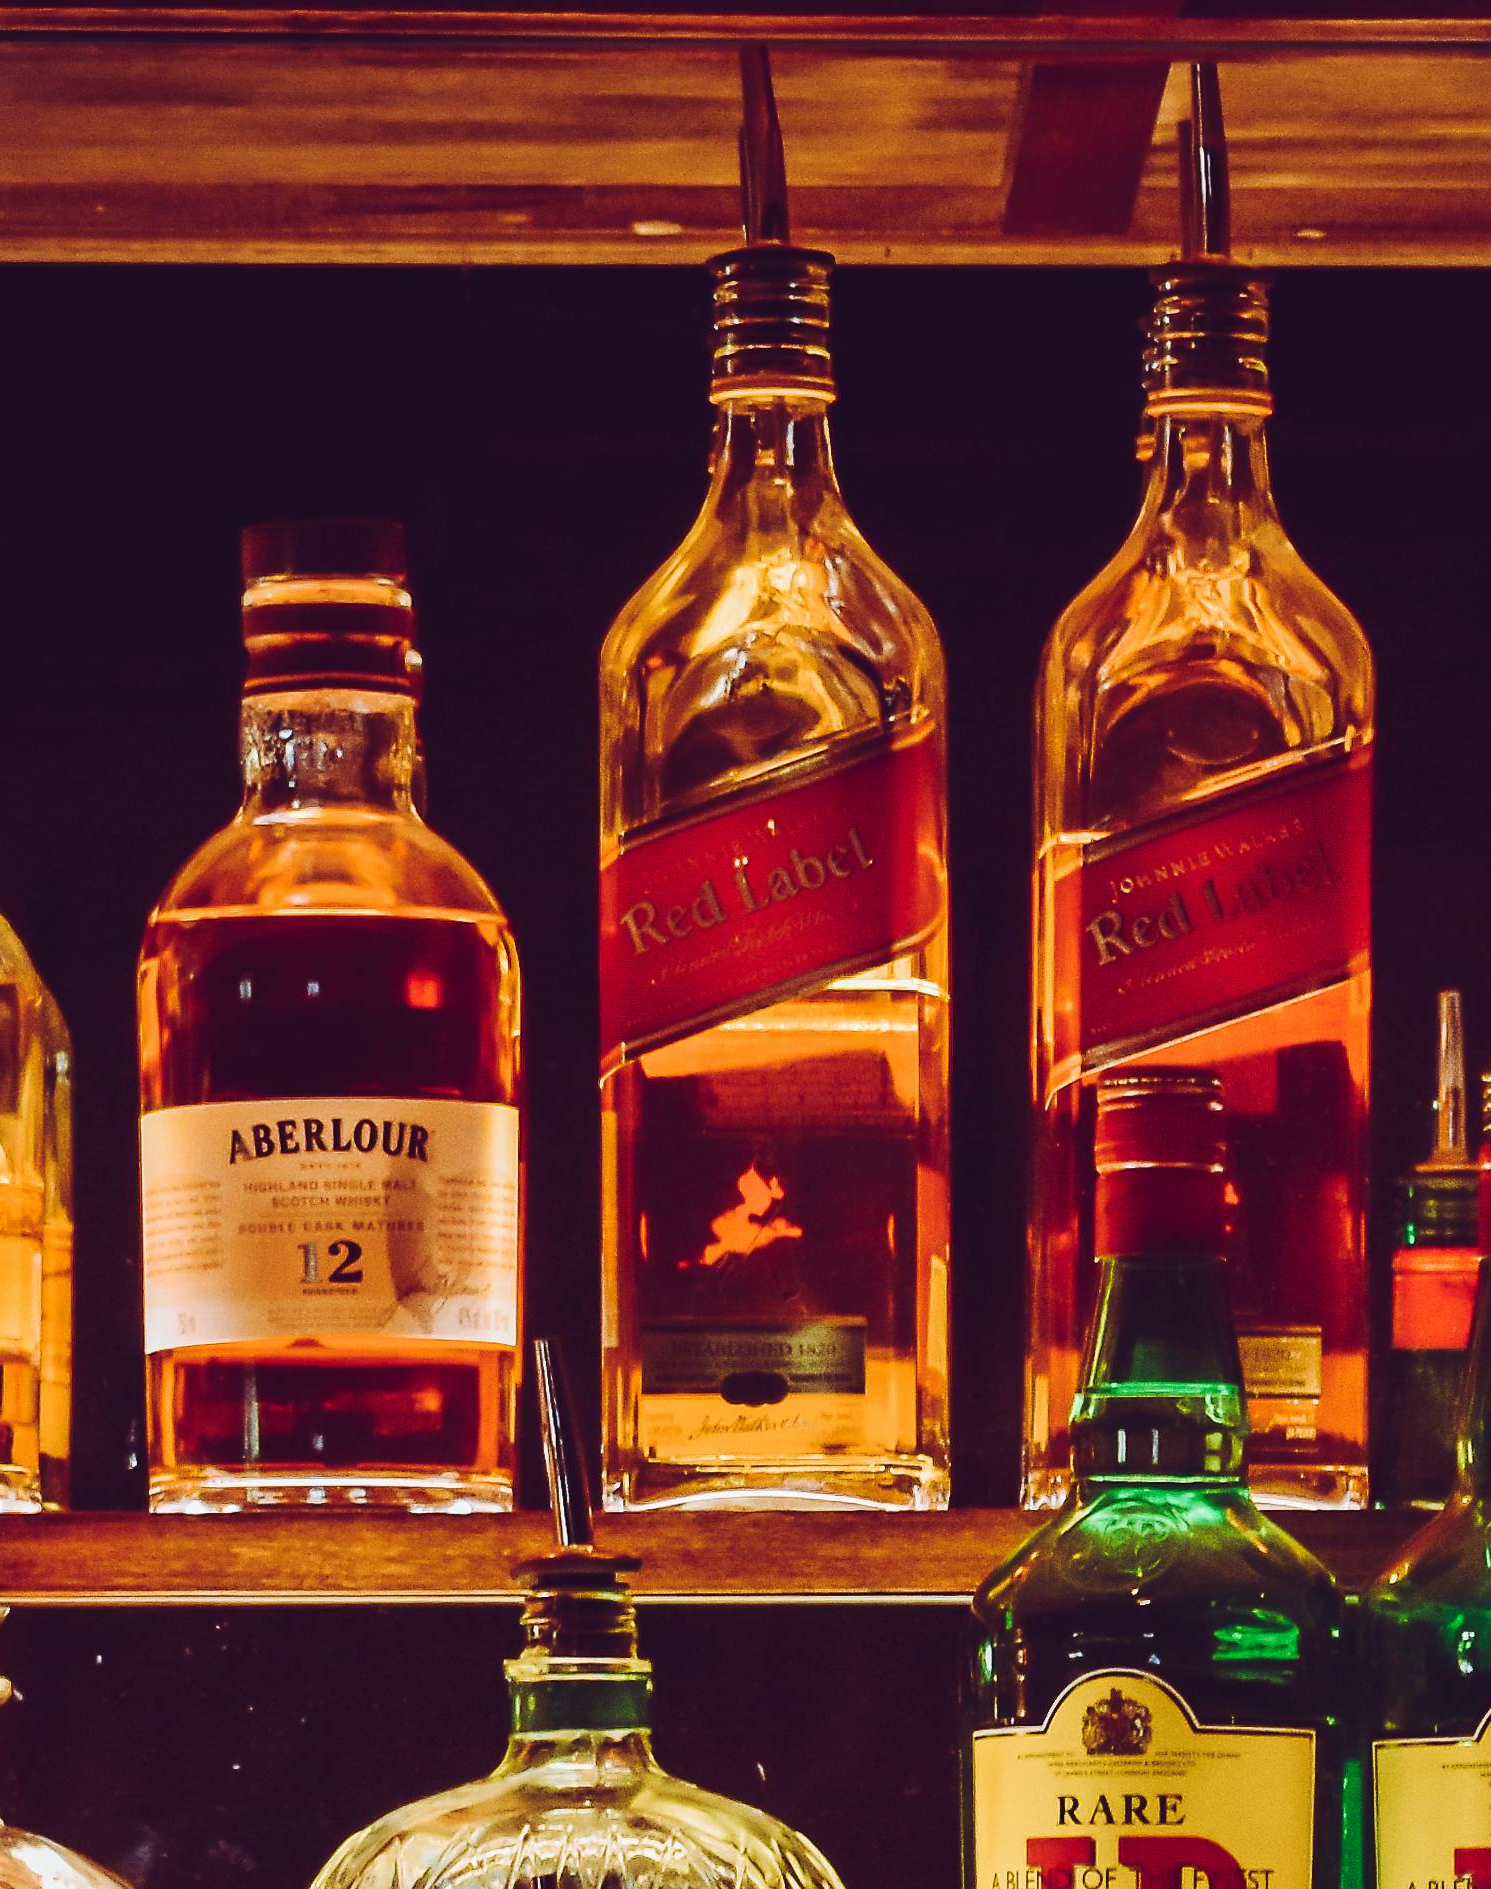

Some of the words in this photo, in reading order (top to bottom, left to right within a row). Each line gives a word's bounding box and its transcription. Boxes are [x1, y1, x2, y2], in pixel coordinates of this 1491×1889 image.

[620, 901, 728, 956] Red
[733, 828, 875, 912] Label
[1110, 855, 1211, 904] JOHNNIE
[1085, 891, 1197, 966] Red
[229, 1118, 430, 1165] ABERLOUR
[243, 1180, 319, 1193] HIGHLAND
[324, 1180, 377, 1191] SINGLE
[272, 1197, 329, 1209] SCOTCH
[335, 1196, 391, 1207] WHISKY
[238, 1222, 295, 1235] DOUBLE
[298, 1240, 364, 1285] 12
[1057, 1793, 1186, 1826] RARE
[1083, 1869, 1115, 1889] OF
